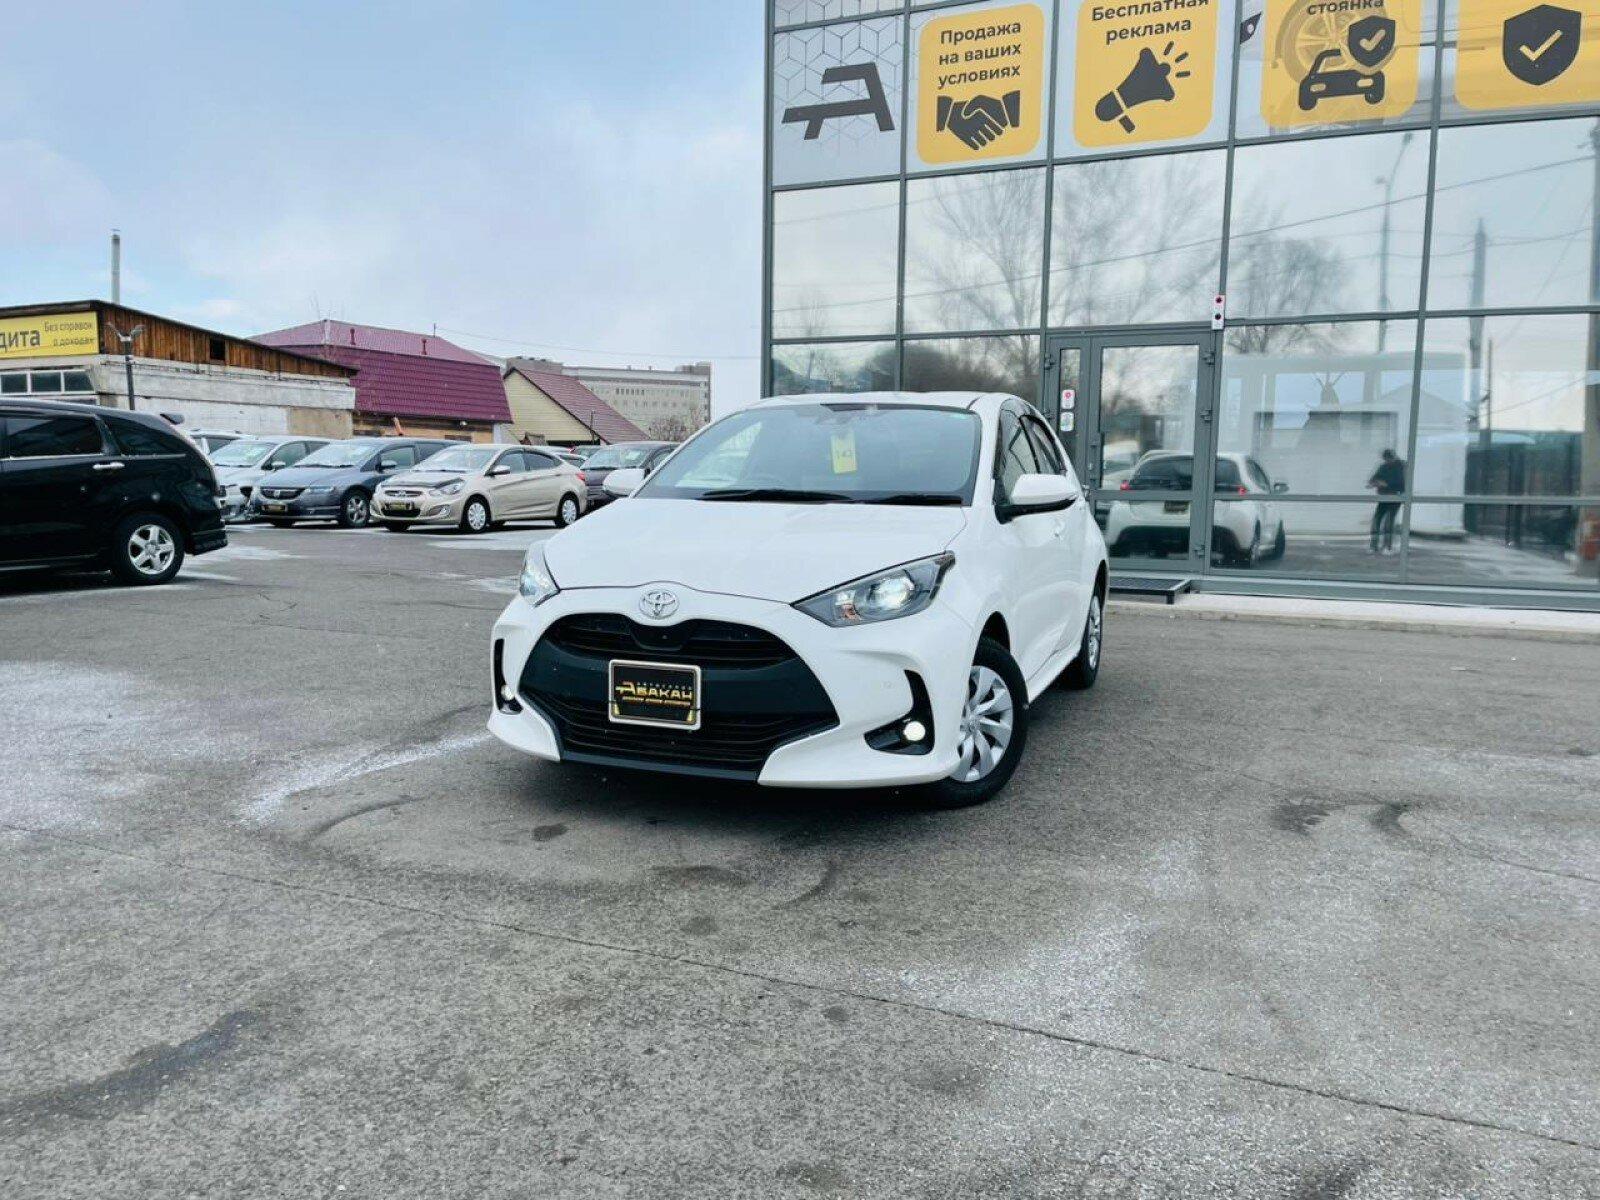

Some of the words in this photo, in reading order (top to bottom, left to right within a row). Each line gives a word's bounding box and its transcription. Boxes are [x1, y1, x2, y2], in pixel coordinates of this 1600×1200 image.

[1307, 0, 1384, 15] стоянка
[941, 22, 1021, 45] Продажа
[1106, 19, 1192, 45] реклама
[939, 52, 959, 66] на
[964, 44, 1021, 62] ваших
[938, 65, 1021, 90] условиях
